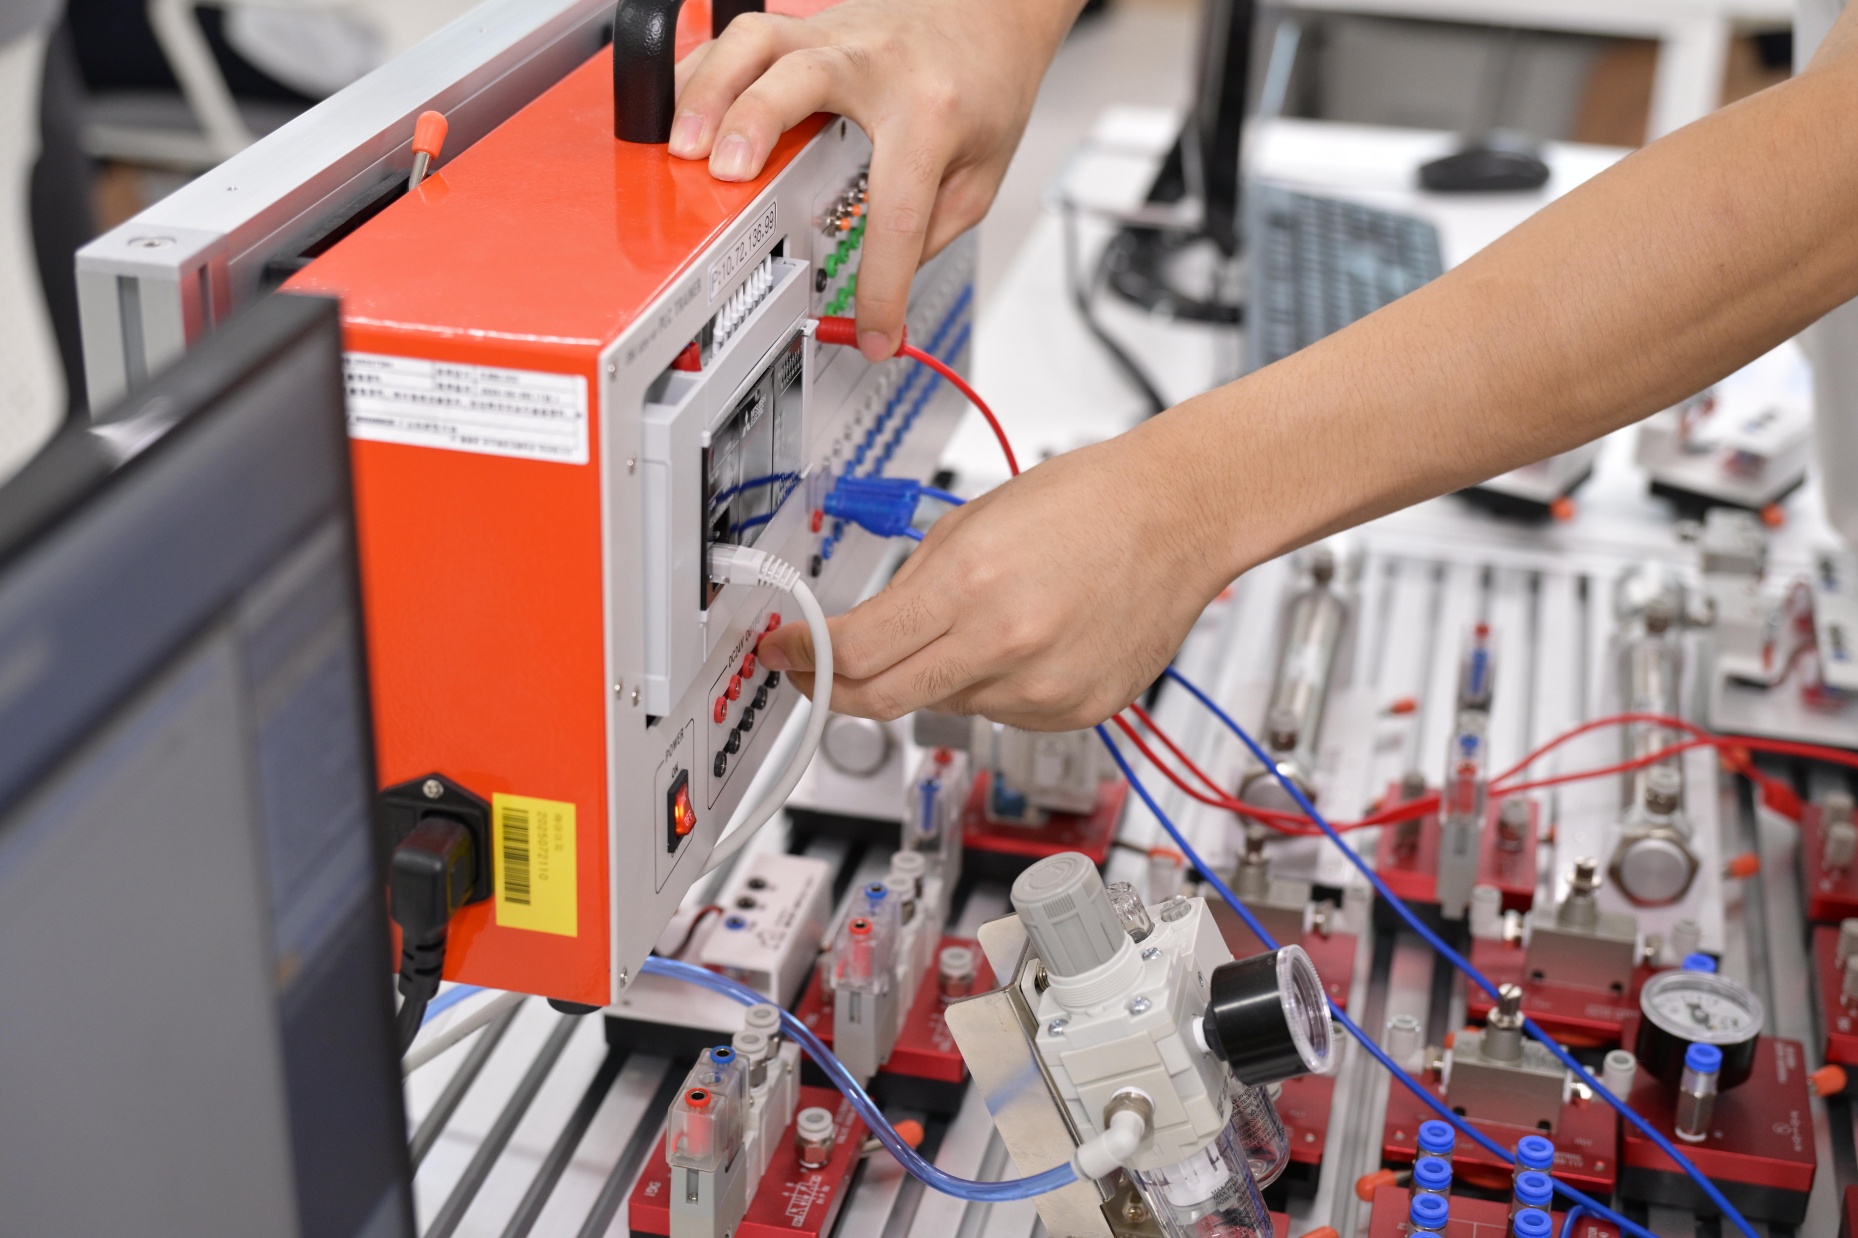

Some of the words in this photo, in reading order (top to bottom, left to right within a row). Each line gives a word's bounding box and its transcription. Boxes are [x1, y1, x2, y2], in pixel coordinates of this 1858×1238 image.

[665, 727, 684, 763] POWER
[671, 761, 679, 779] ON
[684, 809, 693, 826] OFF
